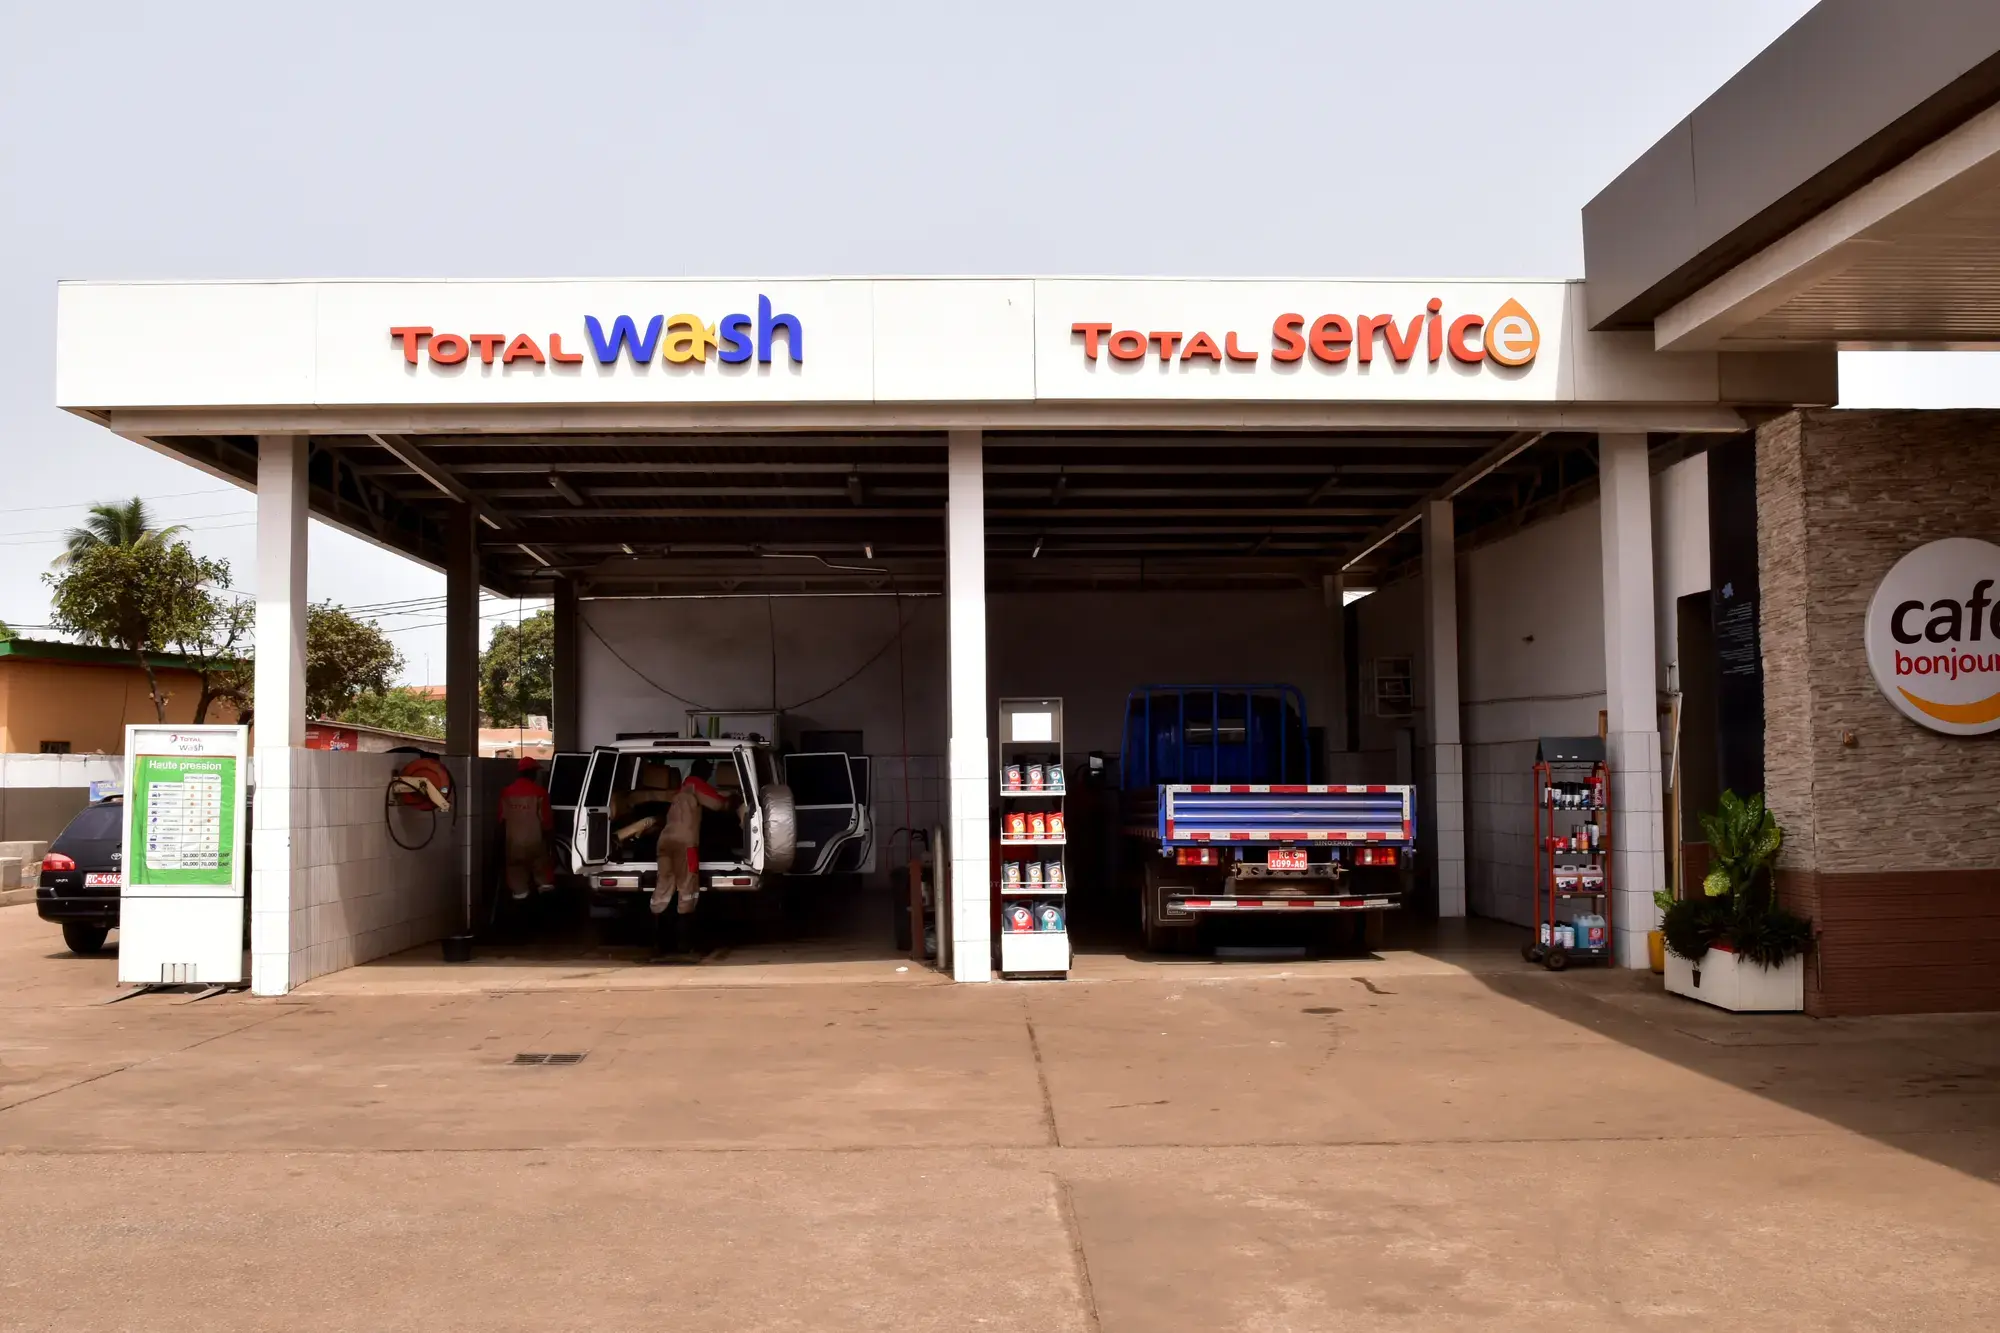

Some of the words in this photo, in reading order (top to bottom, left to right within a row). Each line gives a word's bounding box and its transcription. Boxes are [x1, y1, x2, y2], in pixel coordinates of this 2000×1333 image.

[389, 326, 584, 365] TOTAL
[583, 293, 803, 365] wash
[1071, 322, 1259, 363] TOTAL
[1271, 297, 1540, 367] service
[1890, 579, 2000, 645] caf
[148, 760, 178, 770] Haute
[179, 760, 222, 772] pression
[178, 743, 204, 752] wash
[1278, 851, 1289, 860] RC
